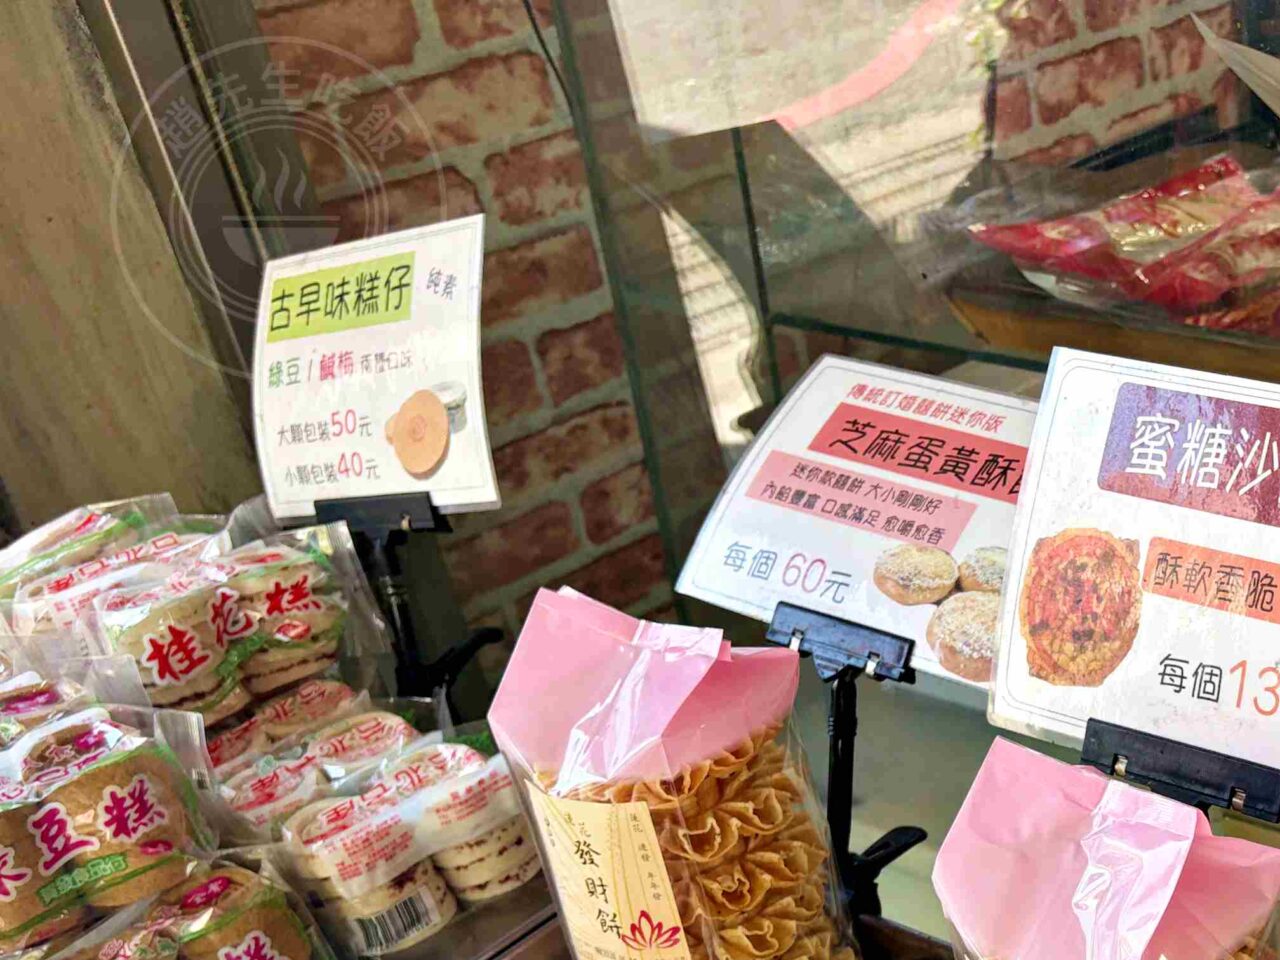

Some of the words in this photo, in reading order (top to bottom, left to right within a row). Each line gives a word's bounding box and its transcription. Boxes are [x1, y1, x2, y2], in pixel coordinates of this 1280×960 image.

[269, 264, 412, 333] 古早味糕仔
[426, 267, 458, 300] 純素
[277, 409, 374, 447] 大顆包裝50元
[284, 452, 382, 488] 小顆包裝40元
[829, 418, 1024, 496] 芝麻蛋黃酥
[820, 498, 882, 528] 口感滿足
[863, 482, 944, 516] 大小剛剛好
[1152, 551, 1279, 614] 酥軟香脆
[145, 574, 323, 683] 桂花糕
[574, 839, 623, 940] 發財餅
